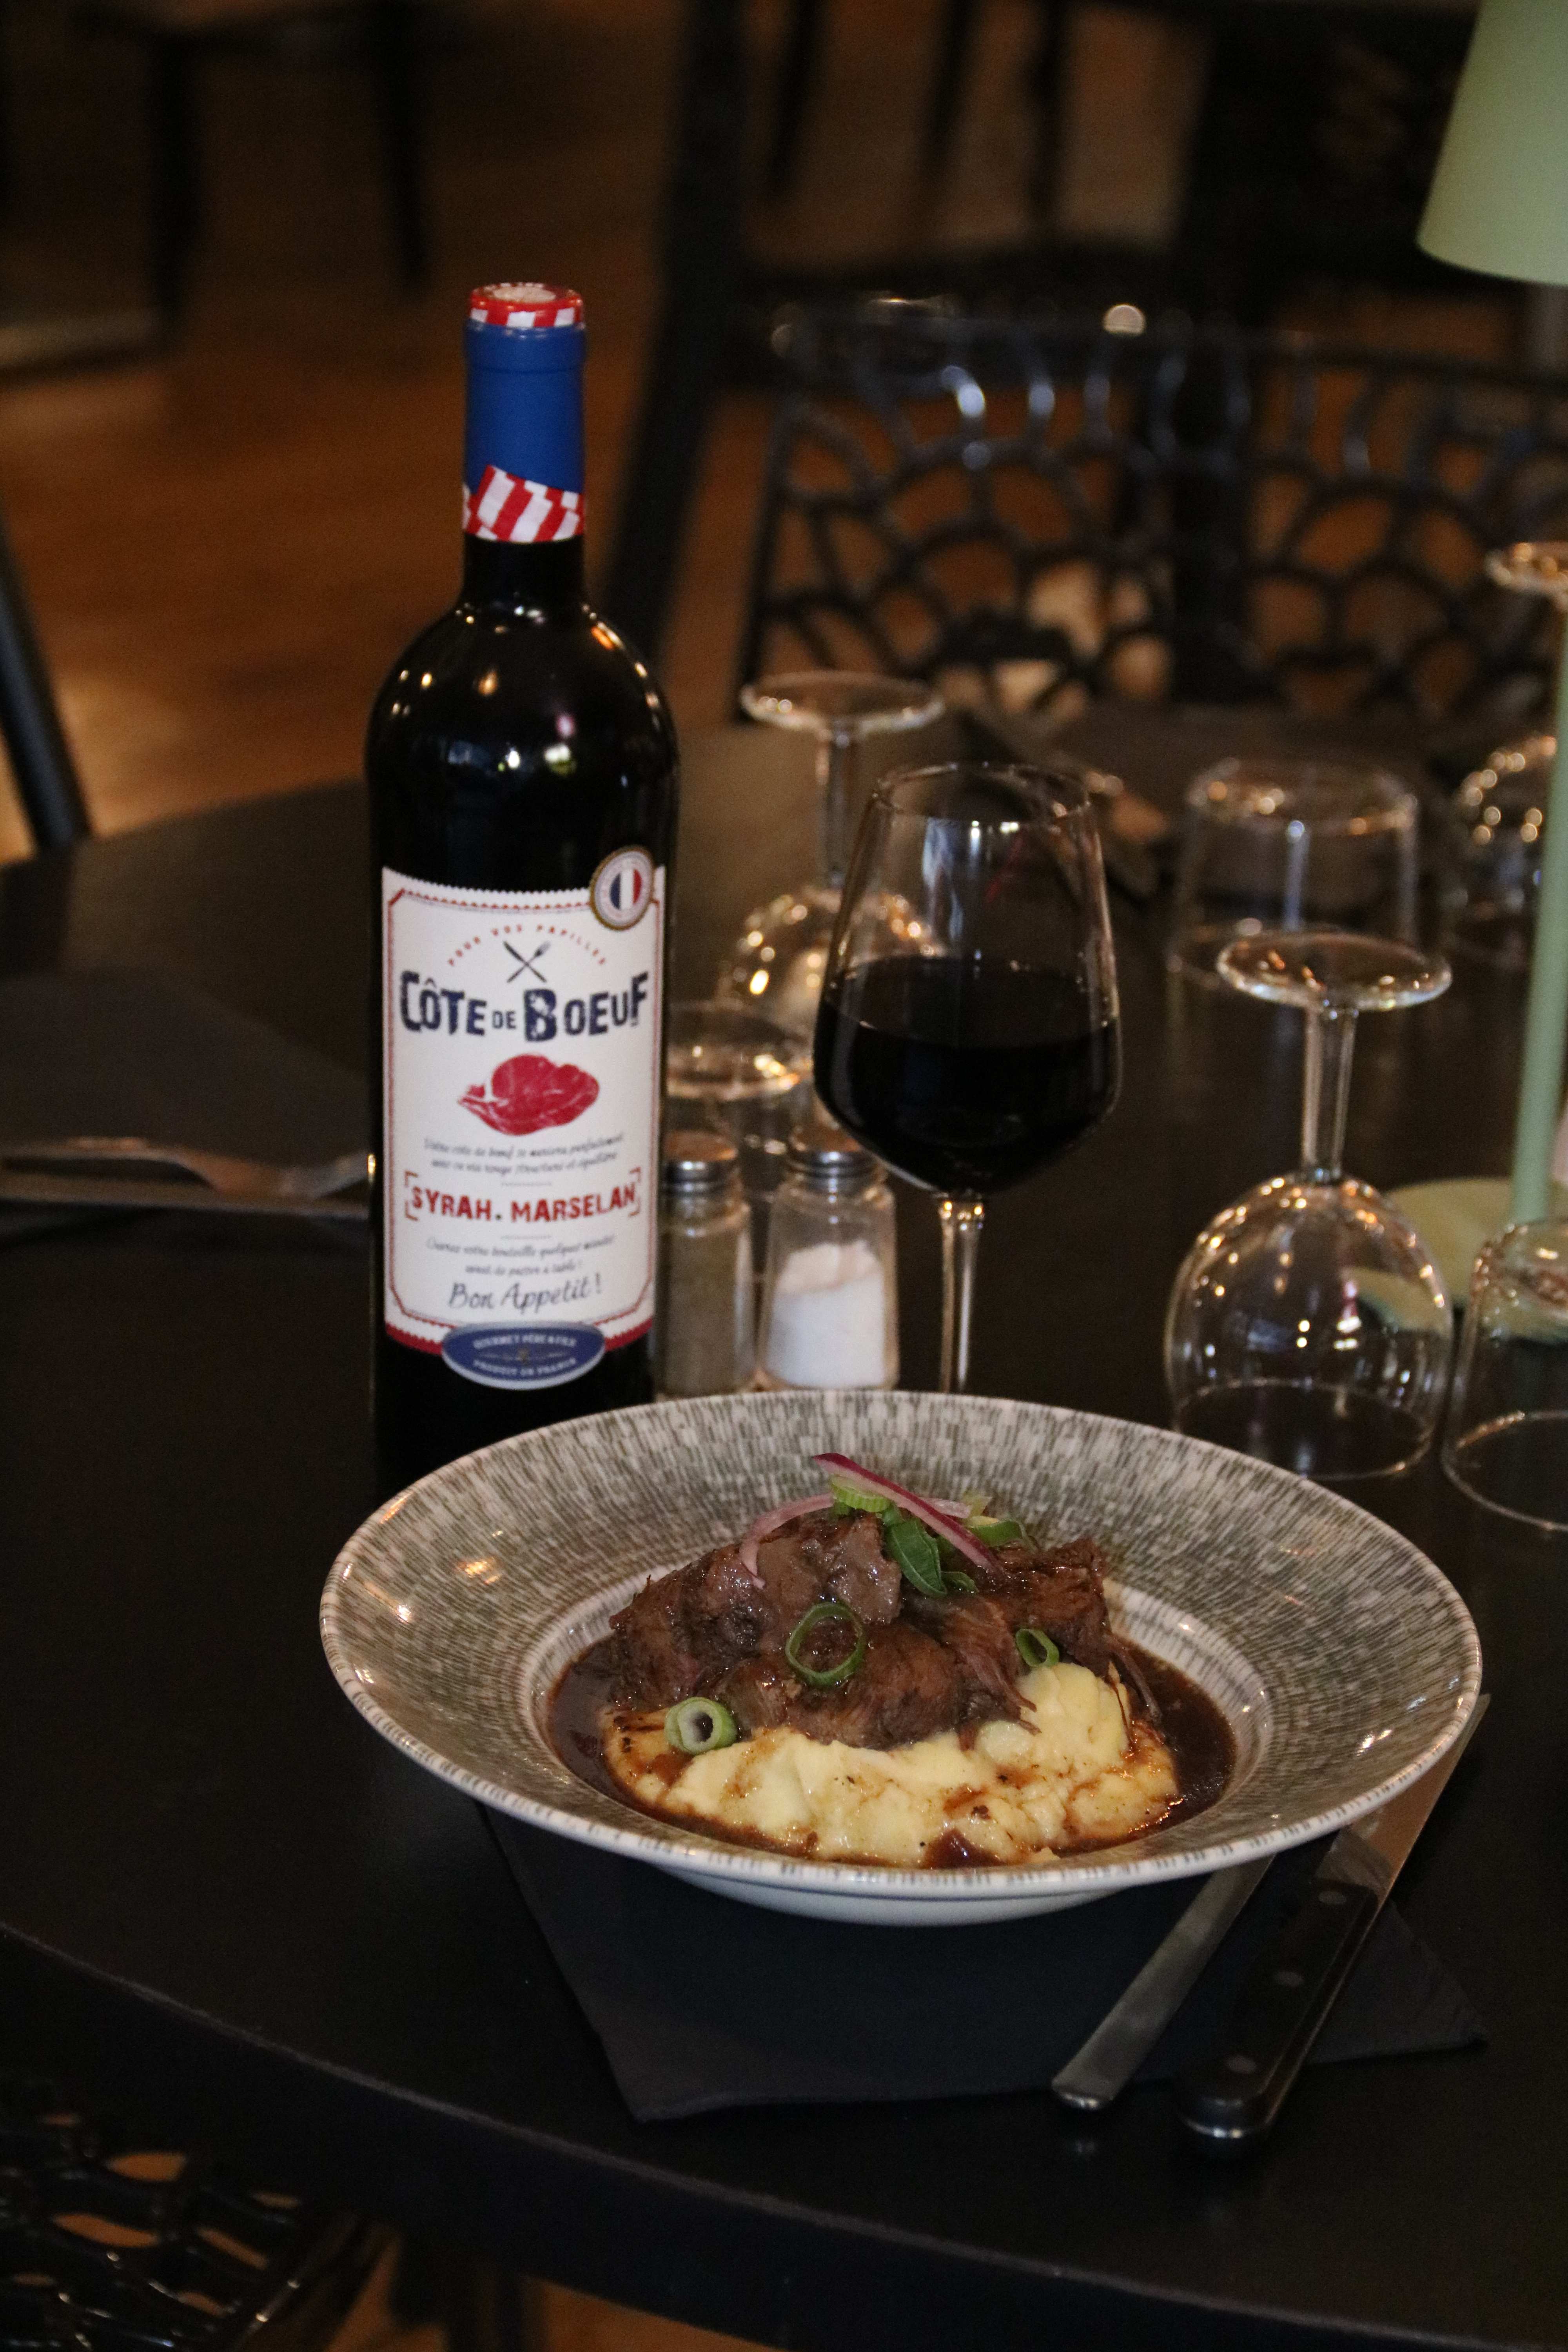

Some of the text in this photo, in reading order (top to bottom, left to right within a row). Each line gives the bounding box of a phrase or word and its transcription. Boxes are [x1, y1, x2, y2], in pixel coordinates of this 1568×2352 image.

[400, 970, 487, 1036] CÔTE
[524, 971, 649, 1042] BOEUF
[511, 1181, 636, 1222] MARSELAN
[448, 1282, 494, 1309] Bon
